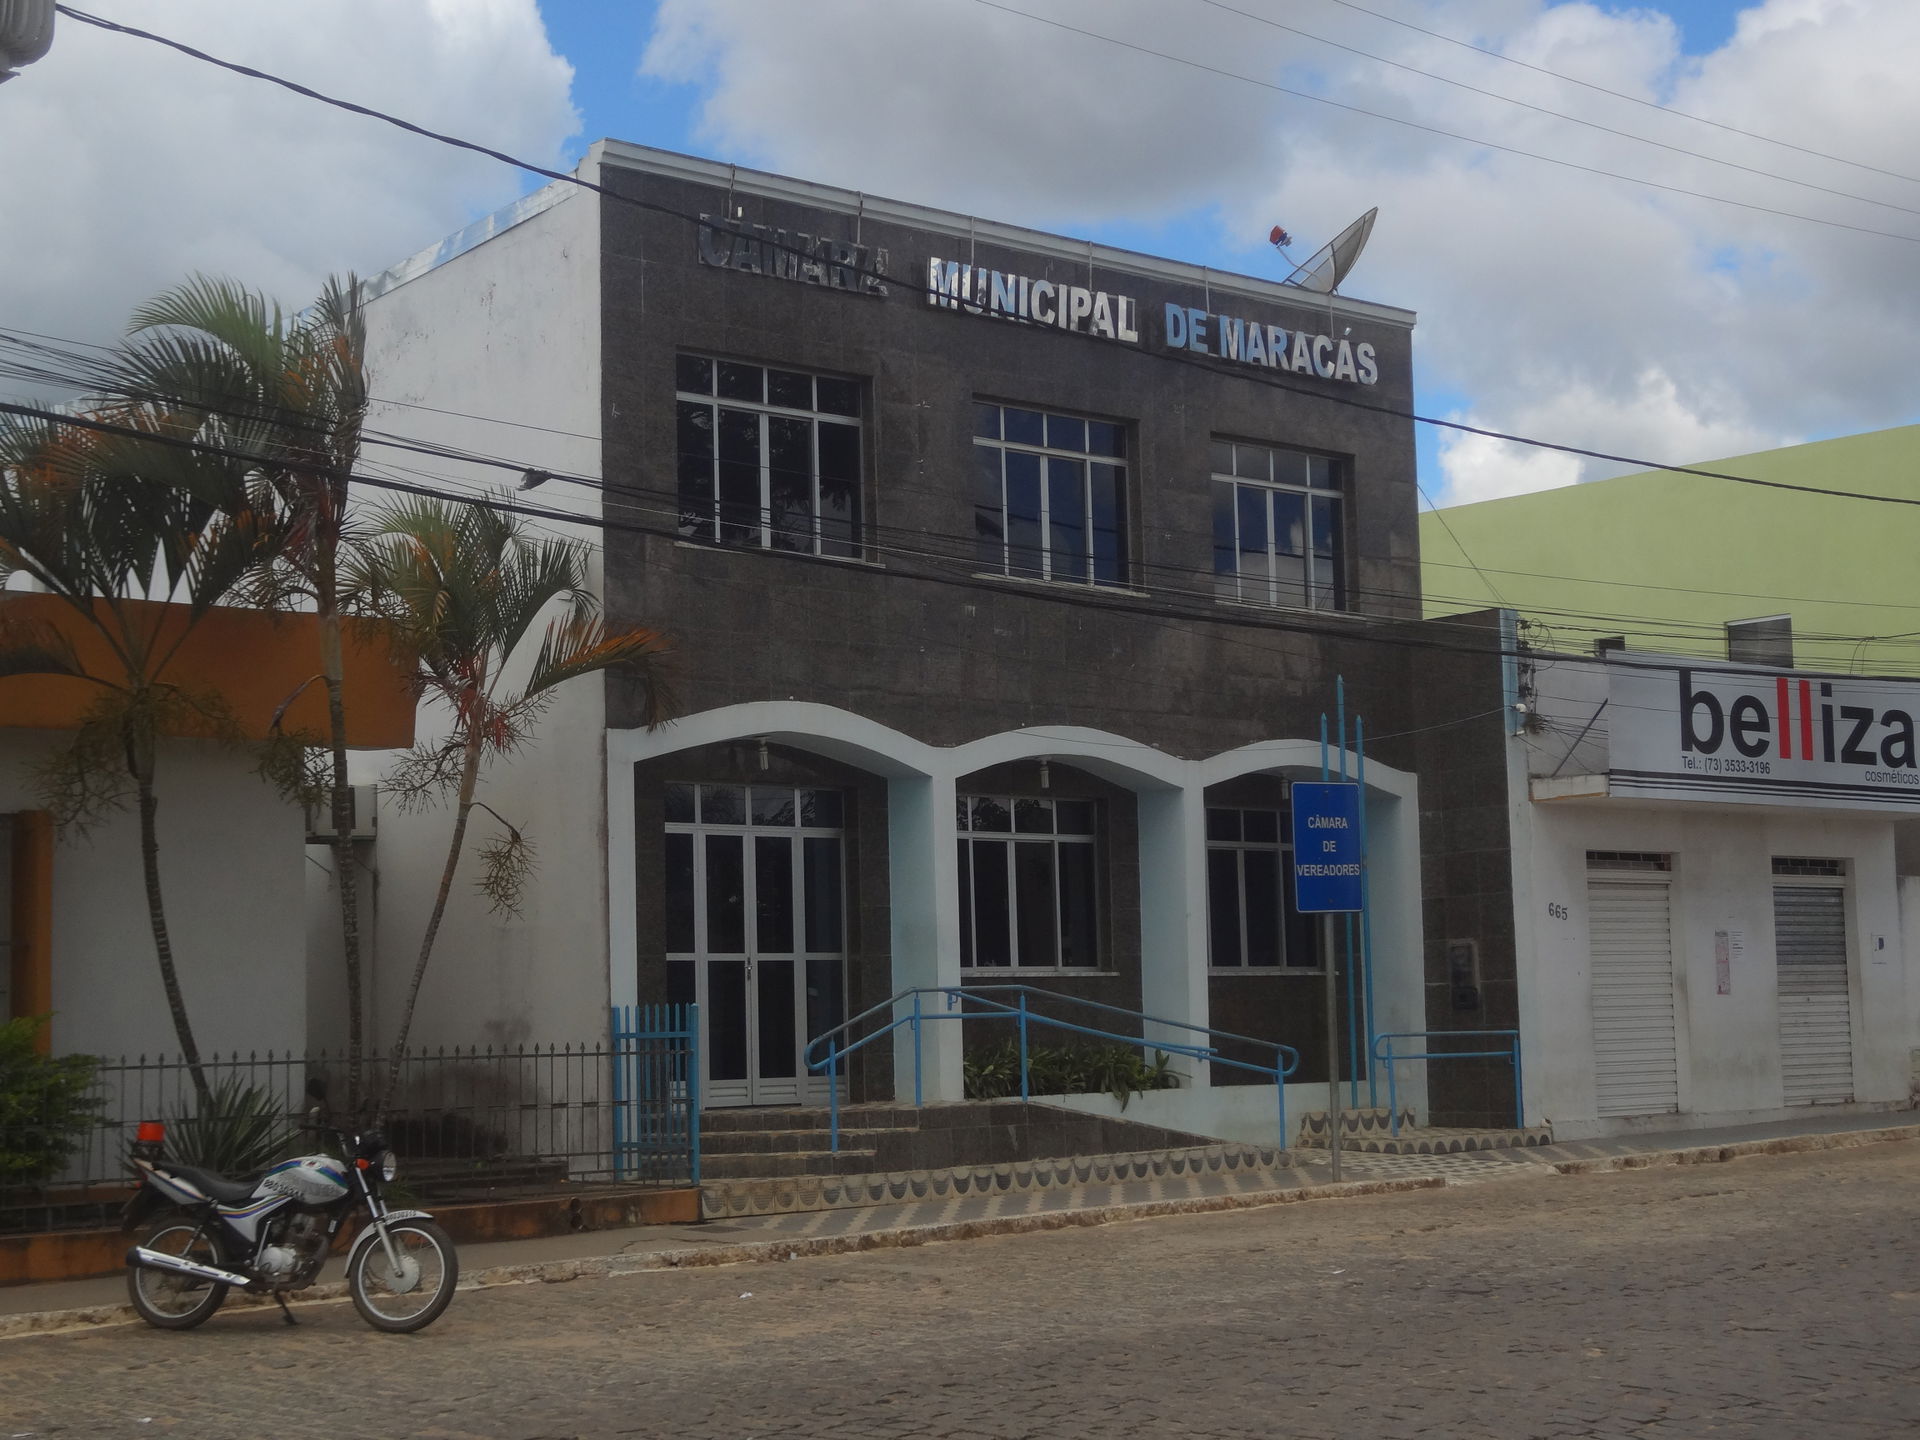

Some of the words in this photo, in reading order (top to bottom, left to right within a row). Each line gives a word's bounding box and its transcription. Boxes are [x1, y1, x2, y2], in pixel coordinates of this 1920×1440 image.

[926, 256, 1139, 343] MUNICIPAL
[1164, 302, 1208, 353] DE
[1220, 317, 1379, 386] MARACÁS
[1679, 669, 1918, 769] belliza
[1704, 757, 1723, 773] (73)
[1724, 758, 1771, 775] 3533-3196
[1865, 769, 1919, 785] cosméticos
[1308, 815, 1348, 829] CÂMARA
[1323, 841, 1336, 852] DE
[1297, 864, 1360, 876] VEREADORES
[1548, 903, 1568, 921] 665
